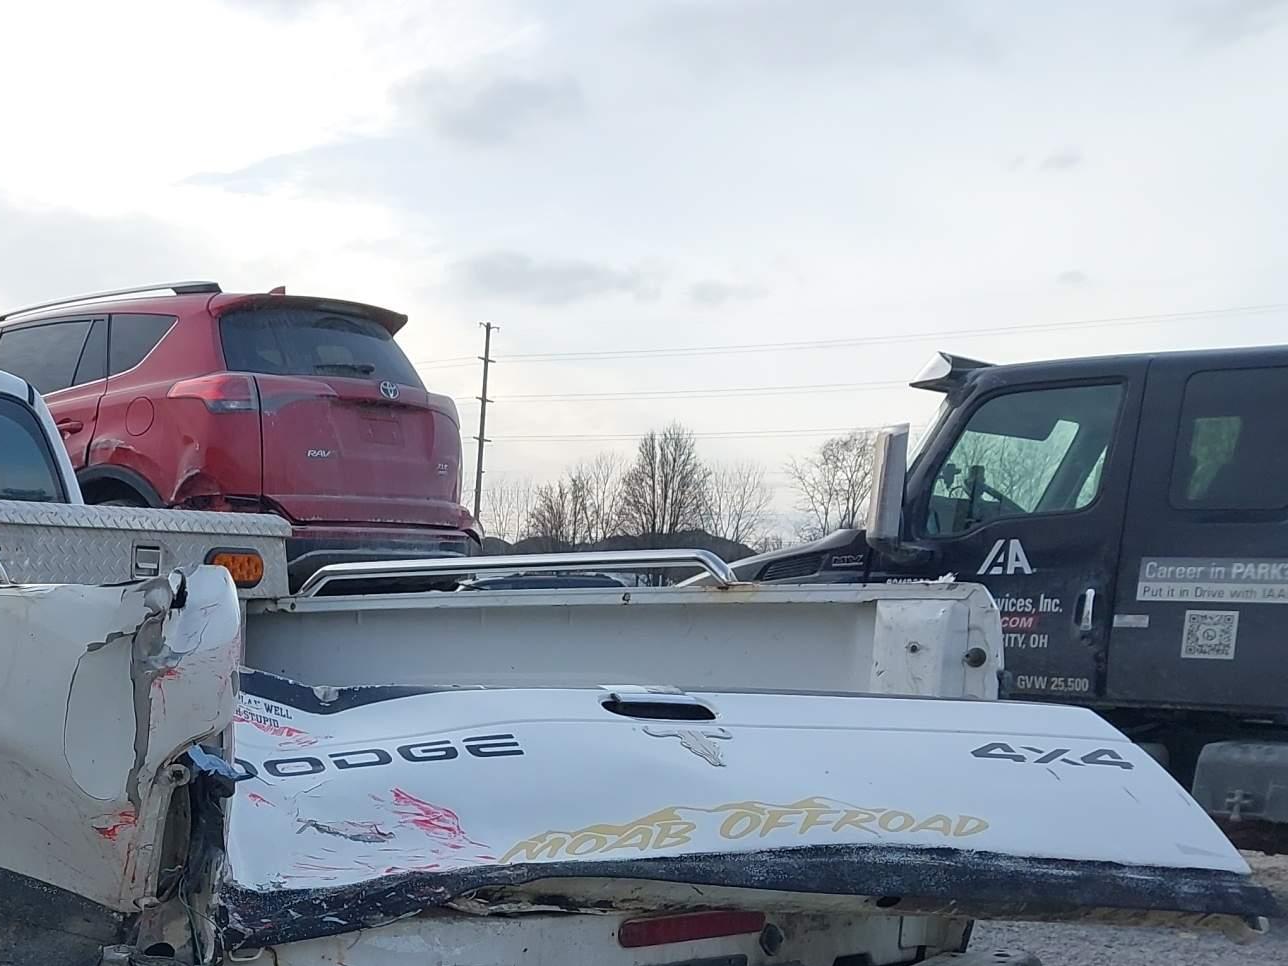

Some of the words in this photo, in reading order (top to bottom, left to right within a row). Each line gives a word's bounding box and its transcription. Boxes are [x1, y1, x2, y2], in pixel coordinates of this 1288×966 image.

[1145, 561, 1206, 579] Career
[1210, 562, 1226, 579] in
[1142, 585, 1162, 597] Put
[1167, 586, 1175, 598] it
[1179, 586, 1189, 598] in
[1194, 586, 1225, 599] Drive
[1230, 586, 1257, 599] with
[1039, 593, 1063, 613] Inc.
[1002, 633, 1026, 649] ITY,
[1030, 633, 1049, 648] OH
[1017, 675, 1048, 689] GVW
[1050, 677, 1089, 692] 25,500
[243, 710, 279, 728] STUPID
[264, 703, 292, 719] WELL
[498, 820, 697, 864] MOAB
[719, 807, 990, 841] OFFROAD
